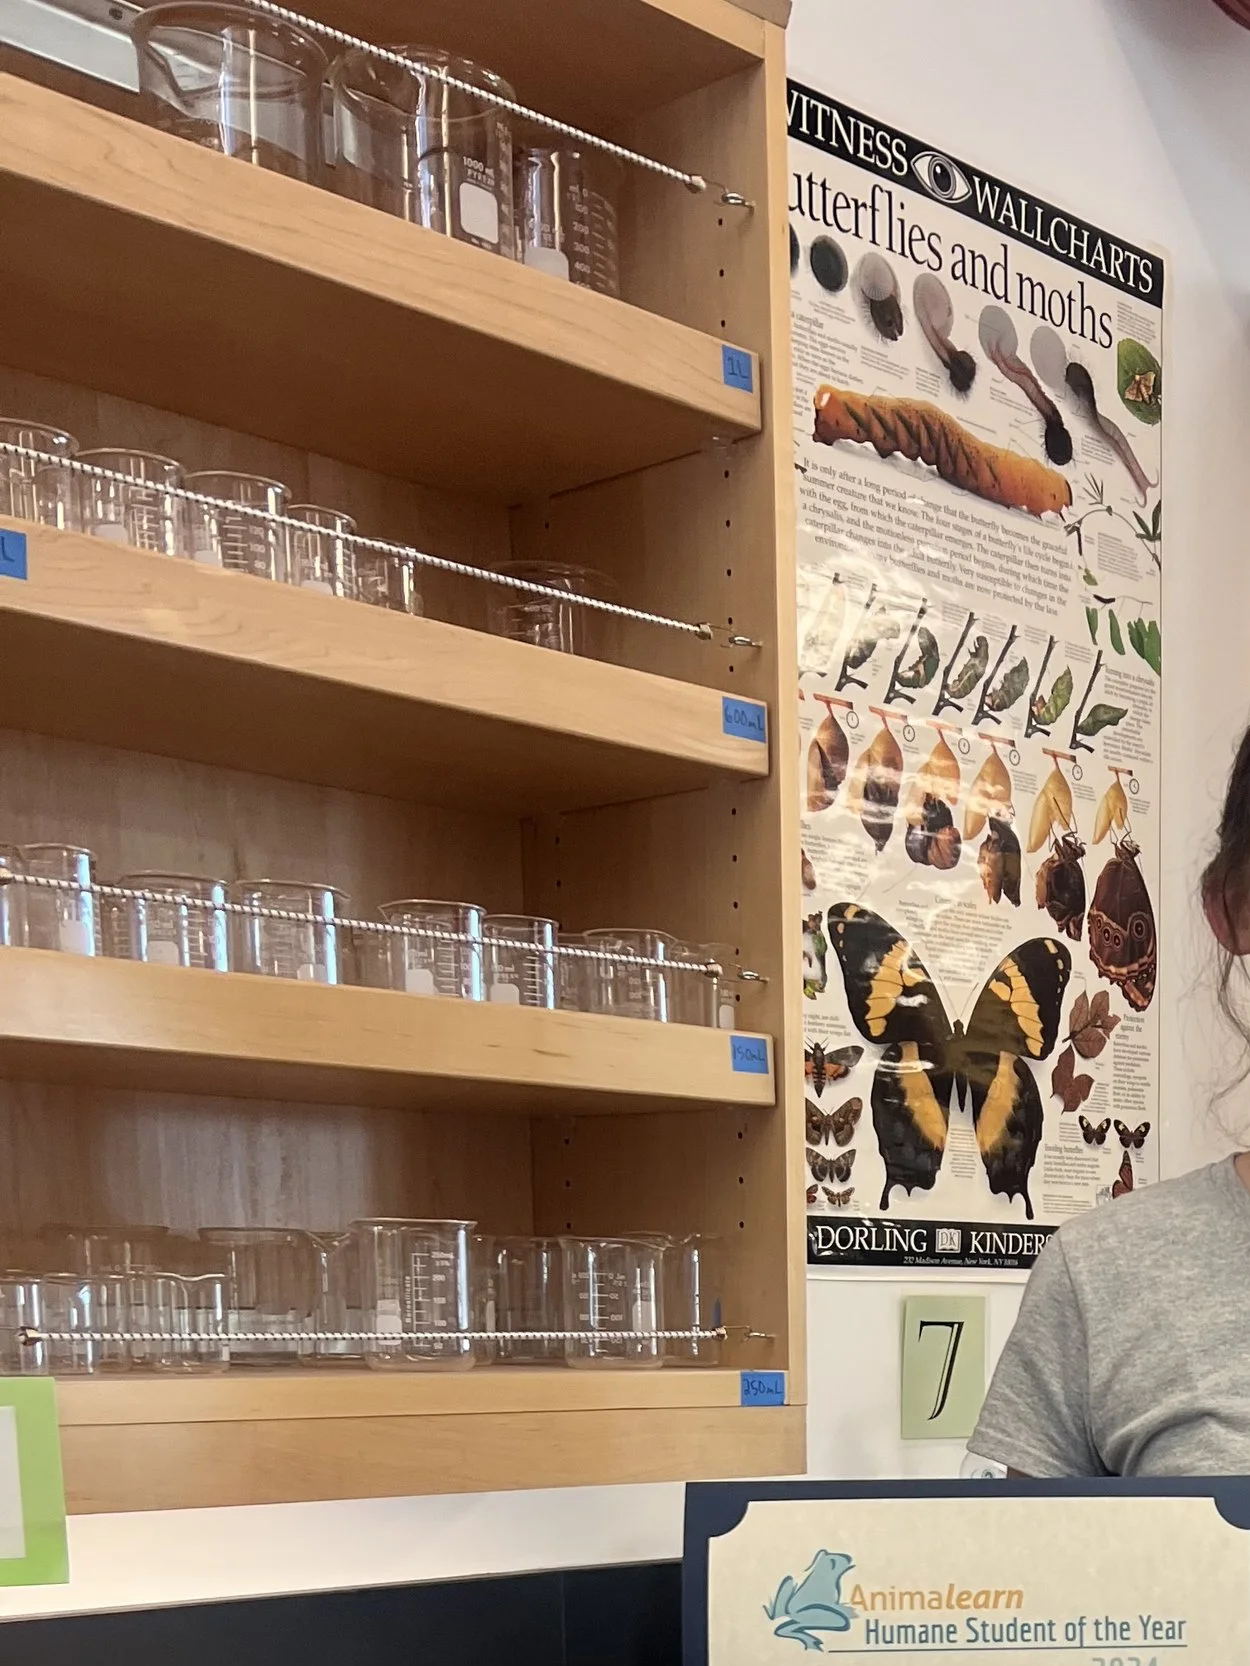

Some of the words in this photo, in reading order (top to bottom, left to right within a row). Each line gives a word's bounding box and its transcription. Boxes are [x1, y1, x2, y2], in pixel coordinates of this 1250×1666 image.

[463, 156, 484, 172] 1000
[973, 175, 1153, 294] WALLCHARTS
[951, 242, 1011, 305] and
[1016, 272, 1113, 349] moths
[816, 1225, 928, 1253] DORLING
[918, 1320, 964, 1421] 7
[850, 1583, 1024, 1611] Animalearn
[865, 1618, 957, 1645] Humane
[966, 1616, 1056, 1643] Student
[1065, 1616, 1087, 1646] of
[1094, 1616, 1131, 1641] the
[1138, 1614, 1186, 1641] Year
